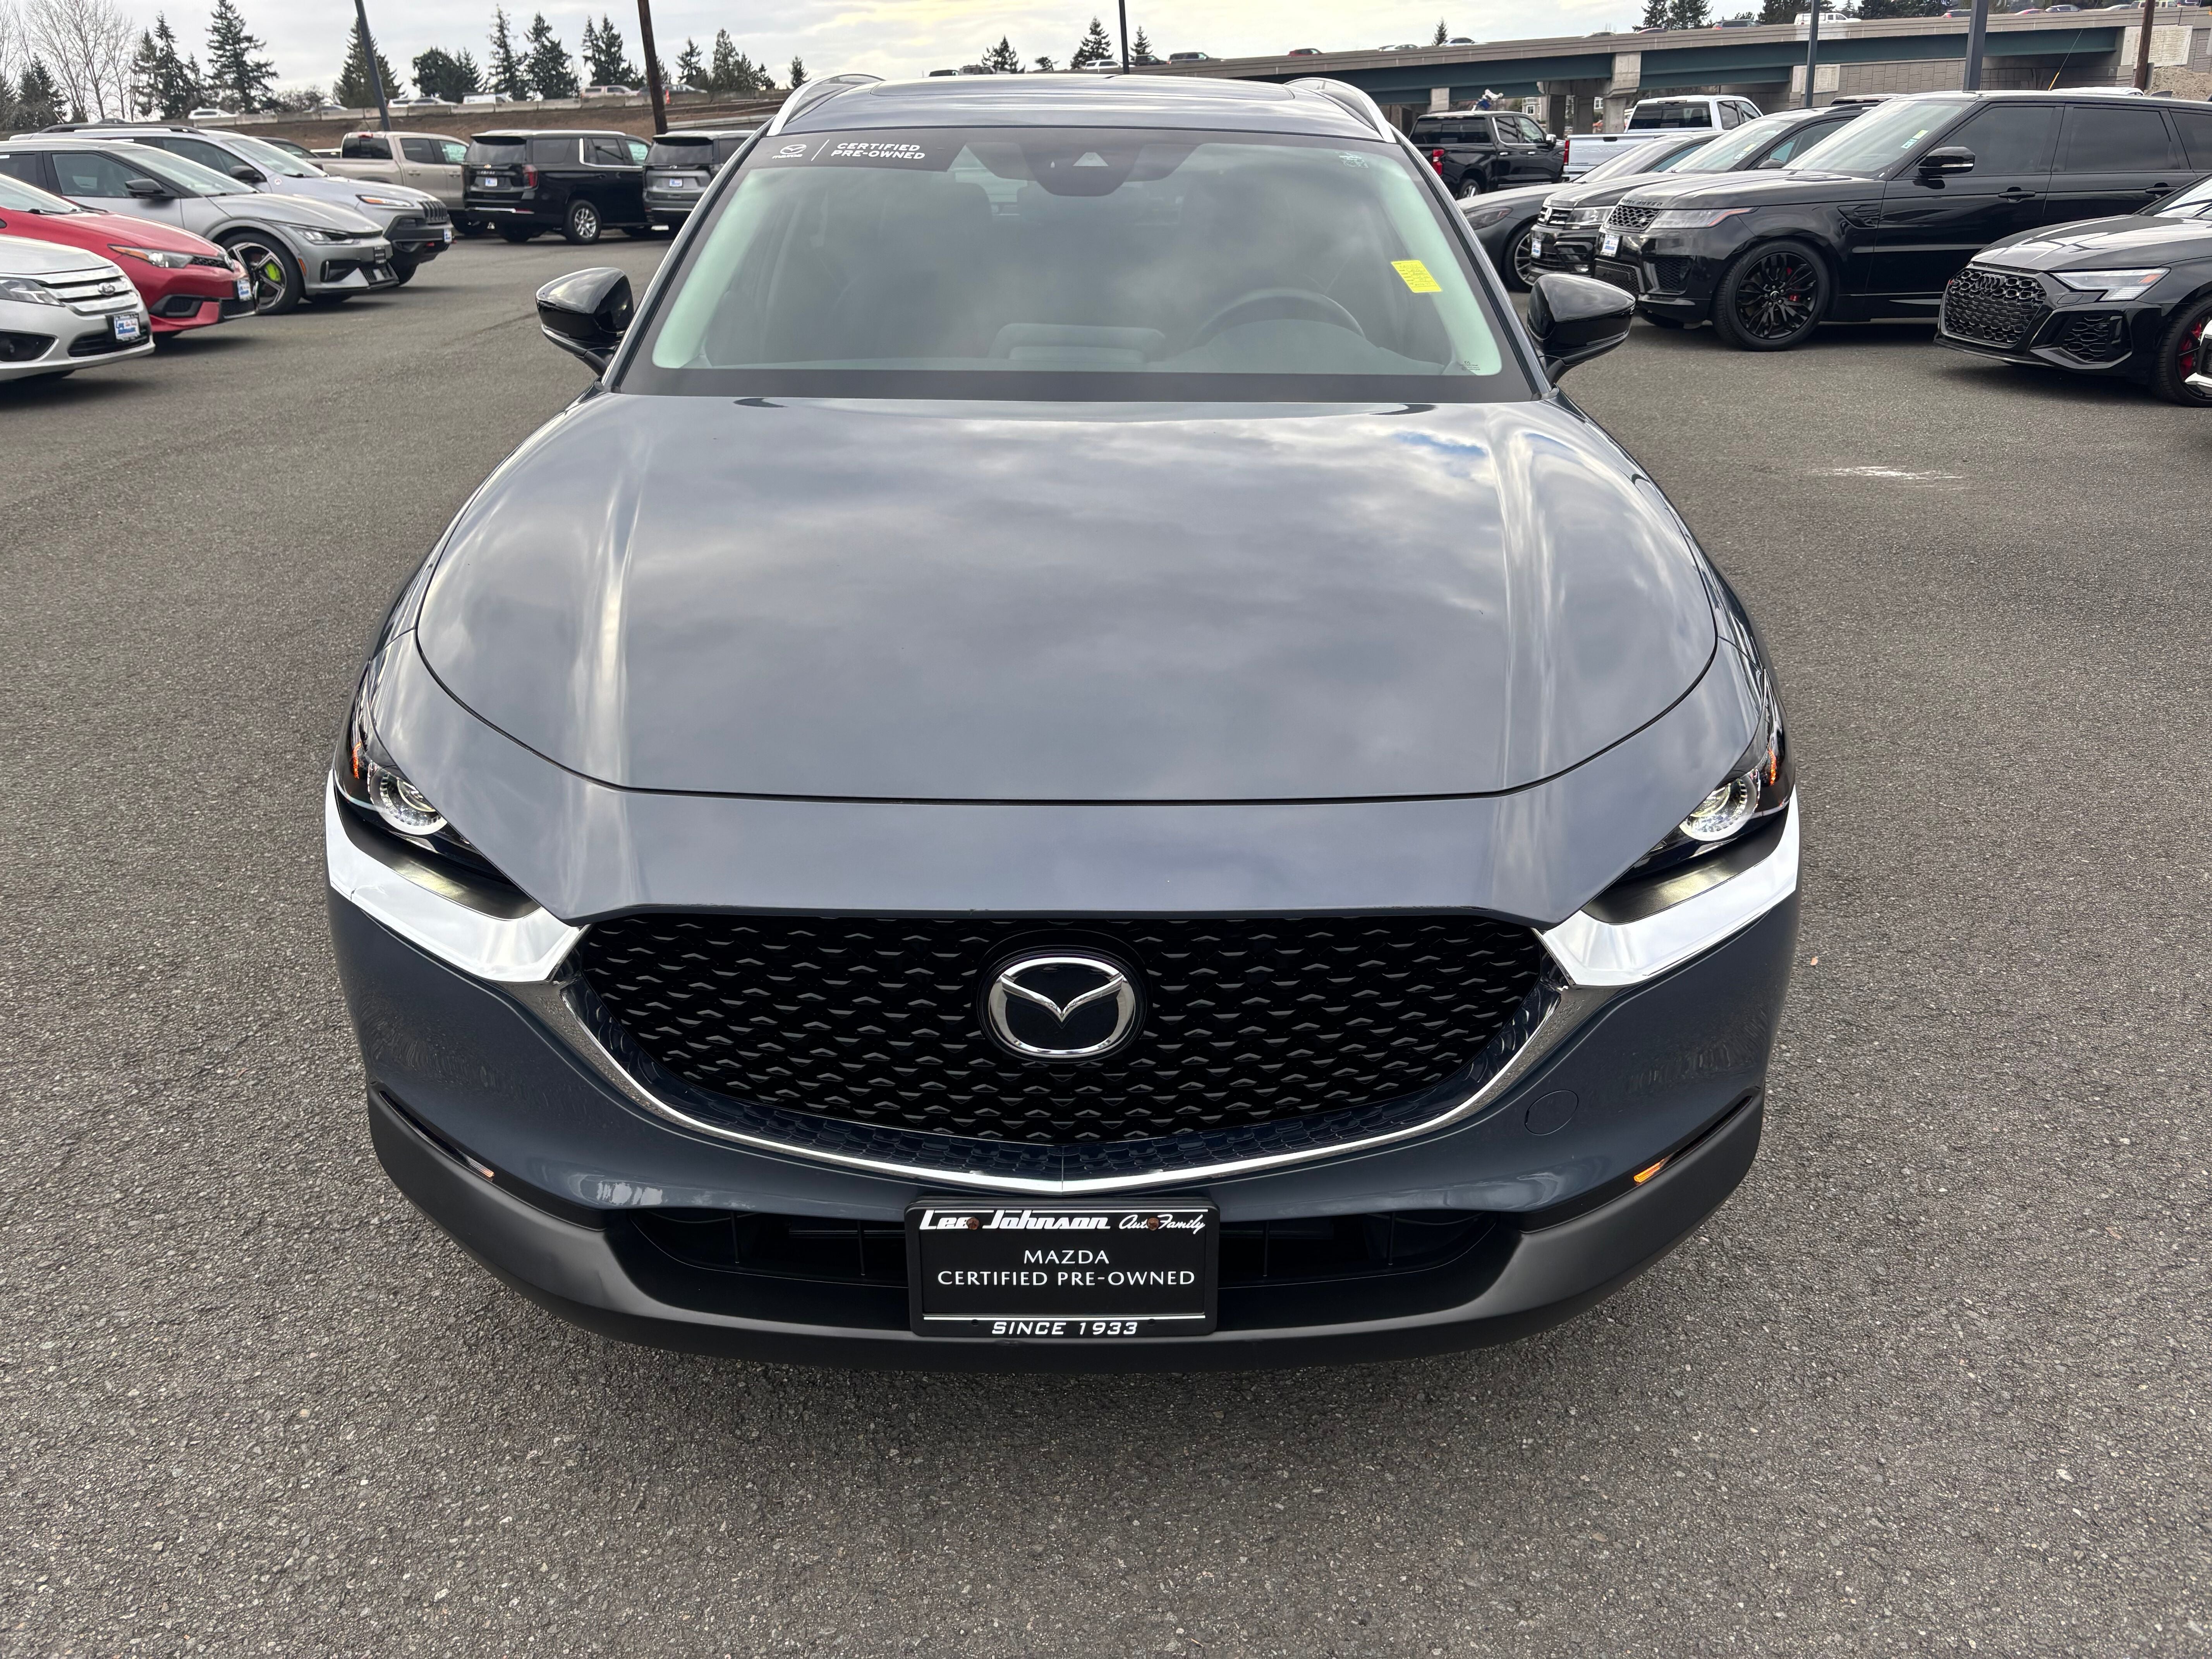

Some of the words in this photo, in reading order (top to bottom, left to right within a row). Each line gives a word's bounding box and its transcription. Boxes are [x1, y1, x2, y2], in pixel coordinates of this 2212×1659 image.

[830, 149, 926, 159] PRE-OWNED
[836, 143, 921, 151] CERTIFIED
[982, 1209, 1111, 1230] Johnson
[1118, 1214, 1150, 1230] Aut
[1157, 1214, 1206, 1235] Family
[1024, 1250, 1110, 1264] MAZDA
[938, 1270, 1047, 1286] CERTIFIED
[1058, 1270, 1195, 1286] PRE-OWNED
[991, 1321, 1067, 1335] SINCE
[1079, 1322, 1138, 1336] 1933
